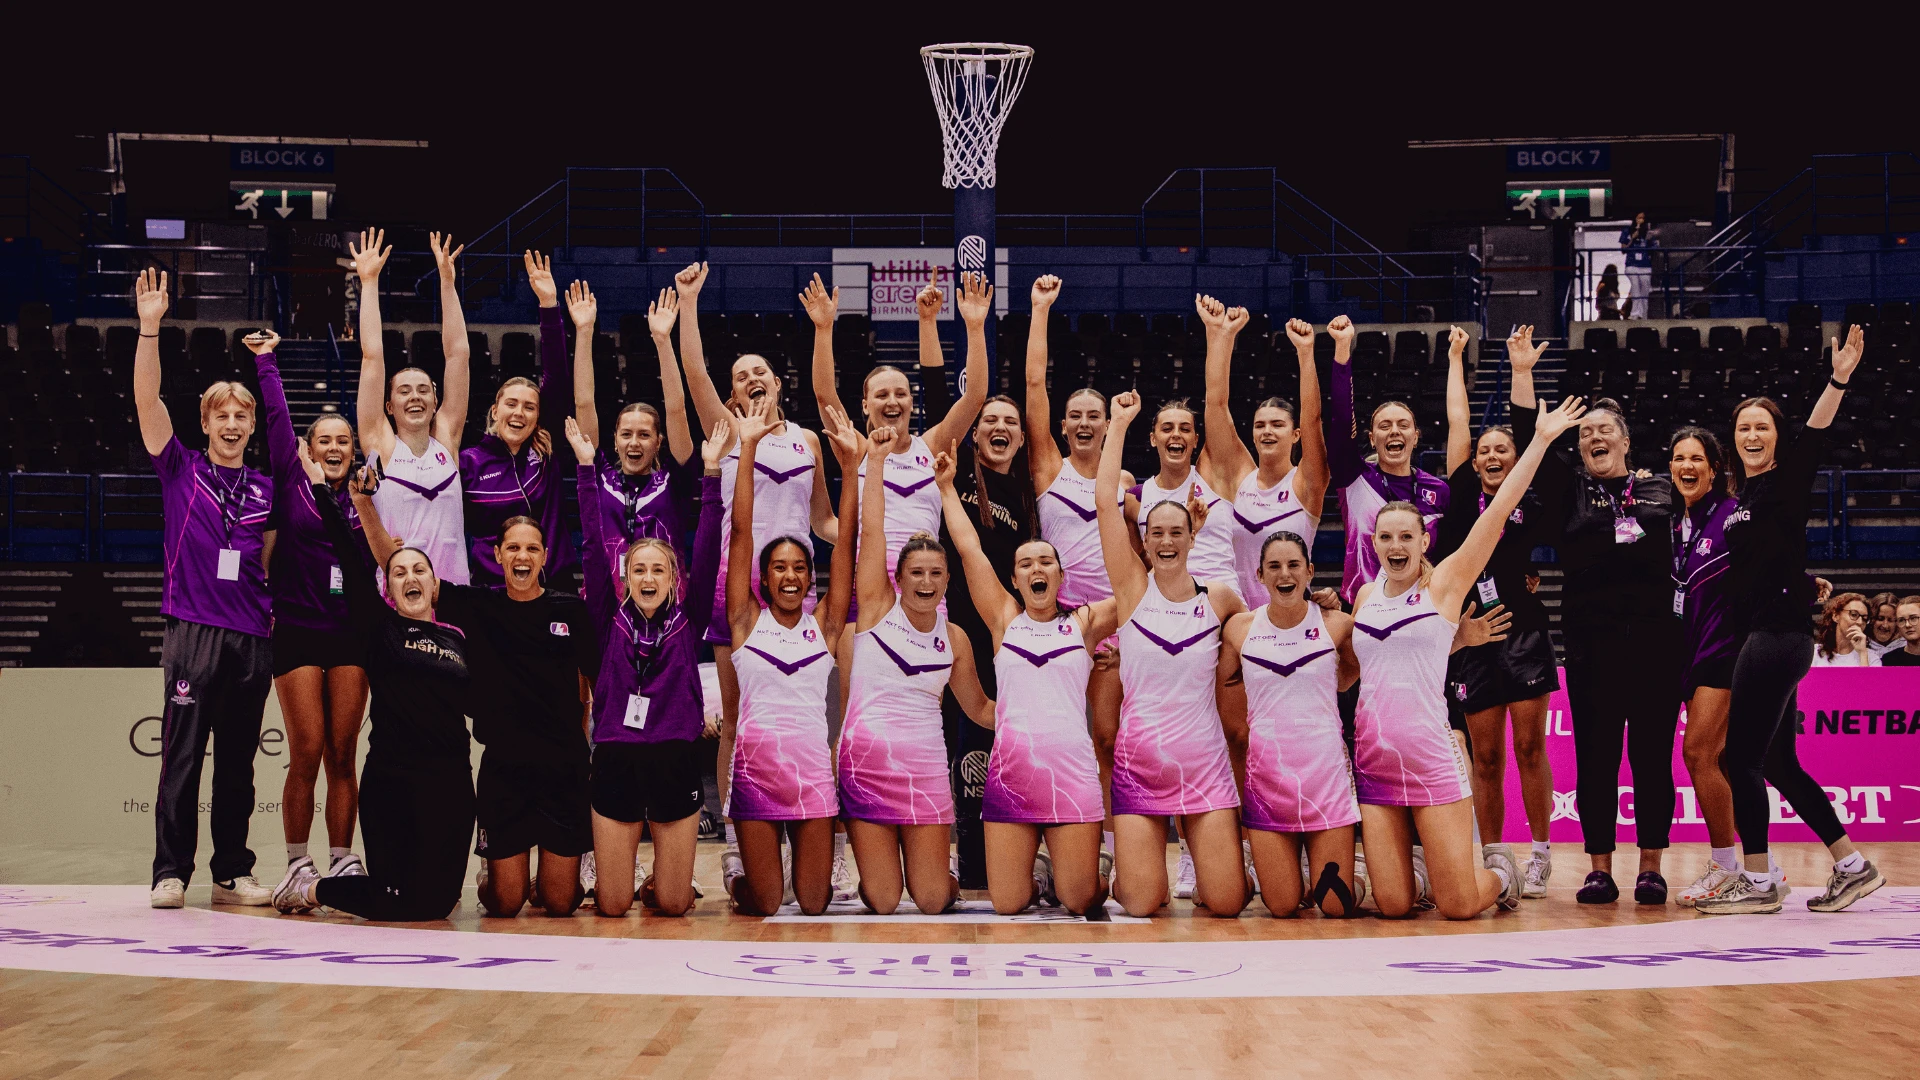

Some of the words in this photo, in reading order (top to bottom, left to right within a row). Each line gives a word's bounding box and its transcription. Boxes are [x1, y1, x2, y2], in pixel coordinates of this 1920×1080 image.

[240, 149, 307, 166] BLOCK
[313, 152, 325, 166] 6
[1516, 150, 1584, 166] BLOCK
[1589, 150, 1601, 165] 7
[872, 260, 949, 282] utilita
[872, 285, 949, 303] are
[872, 306, 949, 315] BIRMINM
[961, 492, 1018, 532] LIGNING
[1443, 722, 1467, 784] LIGHTNIG
[964, 785, 985, 798] NS
[123, 798, 149, 813] the
[1616, 786, 1891, 825] GLERT
[126, 945, 559, 968] SHOT
[1386, 946, 1868, 974] SUPER
